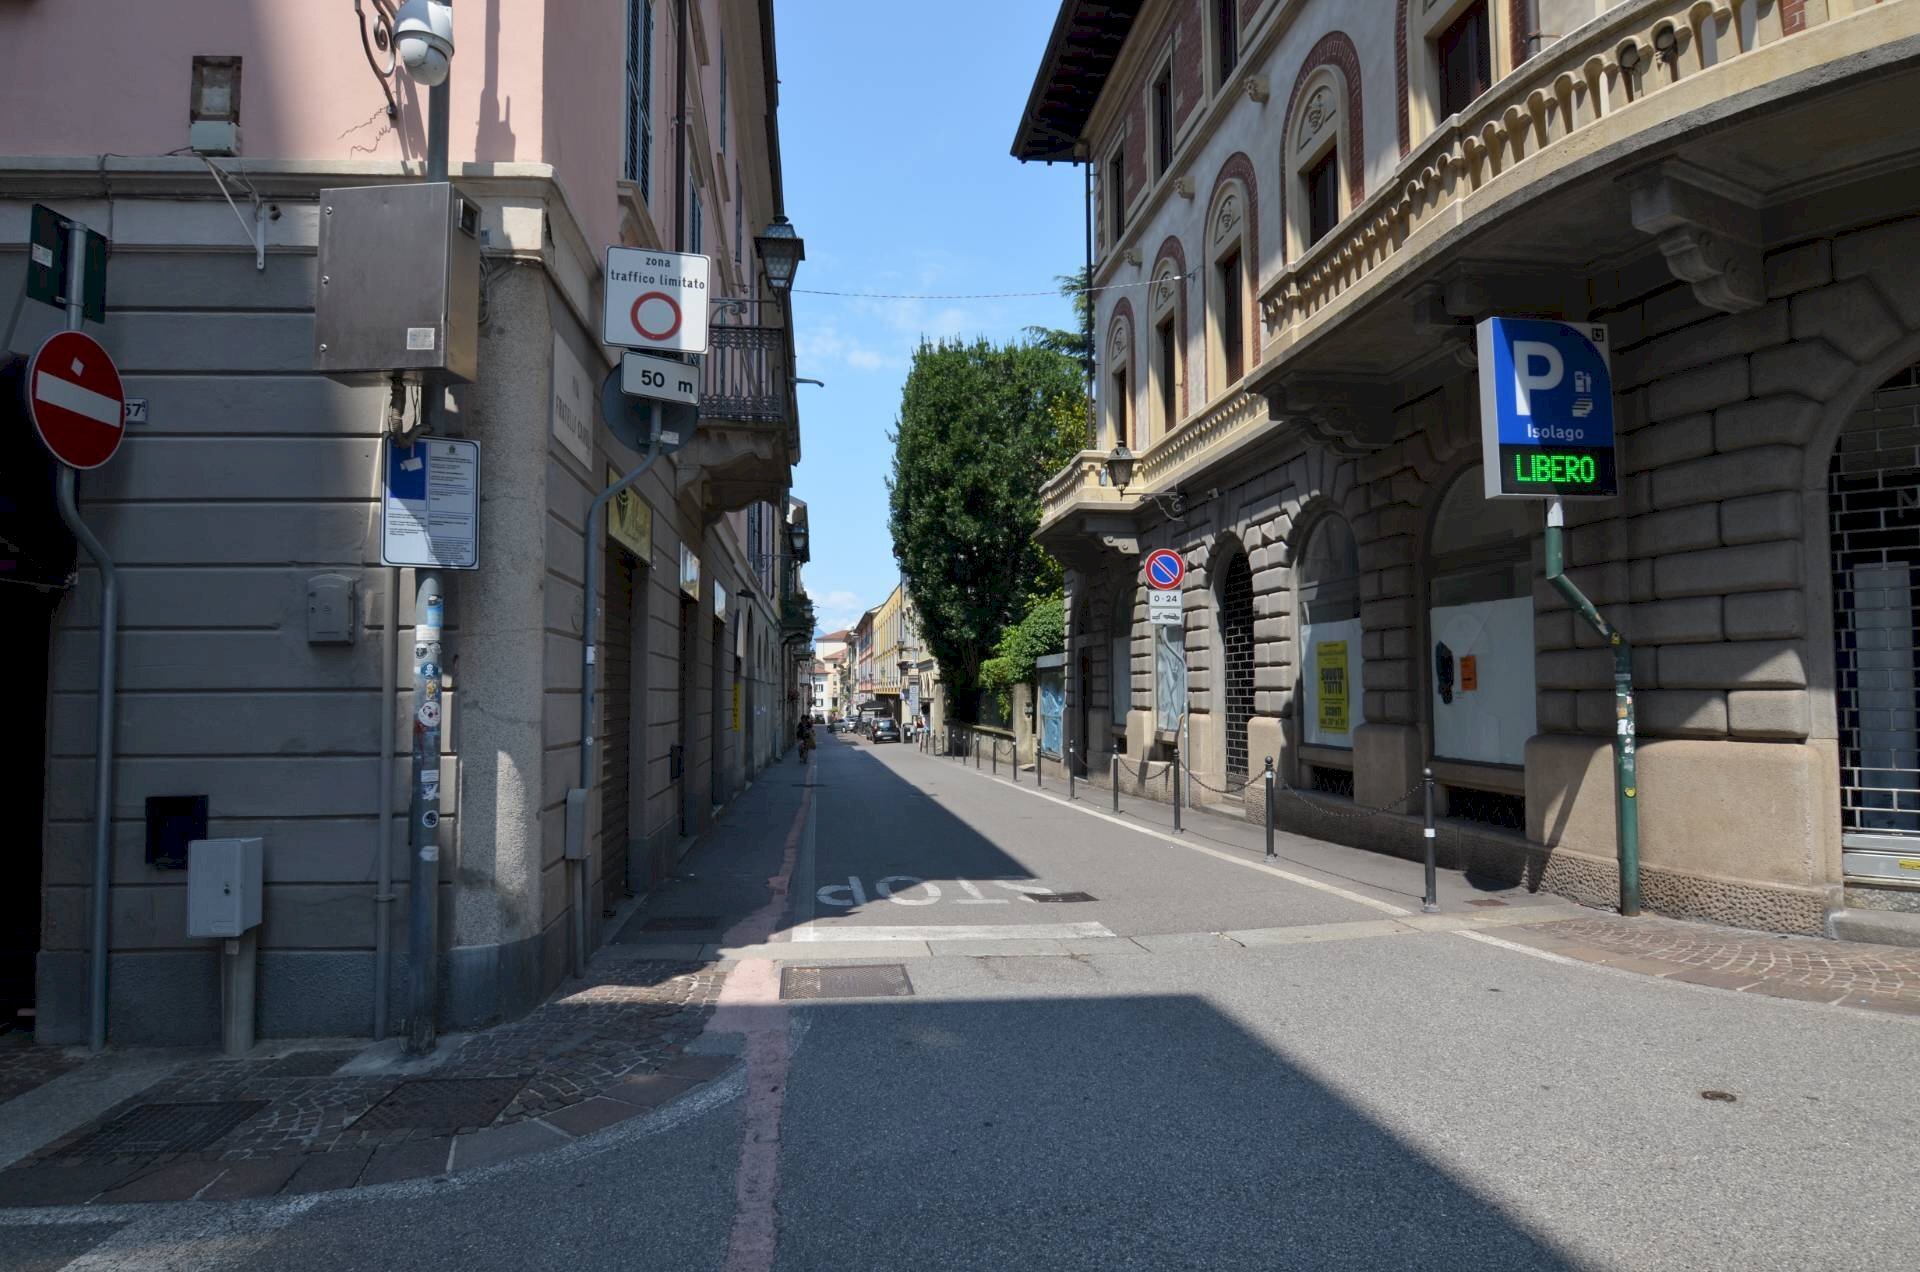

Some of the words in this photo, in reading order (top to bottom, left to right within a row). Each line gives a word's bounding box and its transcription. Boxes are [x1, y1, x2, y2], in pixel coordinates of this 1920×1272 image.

[646, 257, 671, 268] zona
[610, 269, 655, 285] traffico
[659, 275, 705, 290] limitato
[641, 369, 665, 388] 50
[678, 380, 693, 394] m
[1513, 340, 1564, 416] P
[1527, 423, 1584, 441] Isolago
[1515, 454, 1595, 483] LIBERO
[1324, 681, 1343, 695] TUTTO
